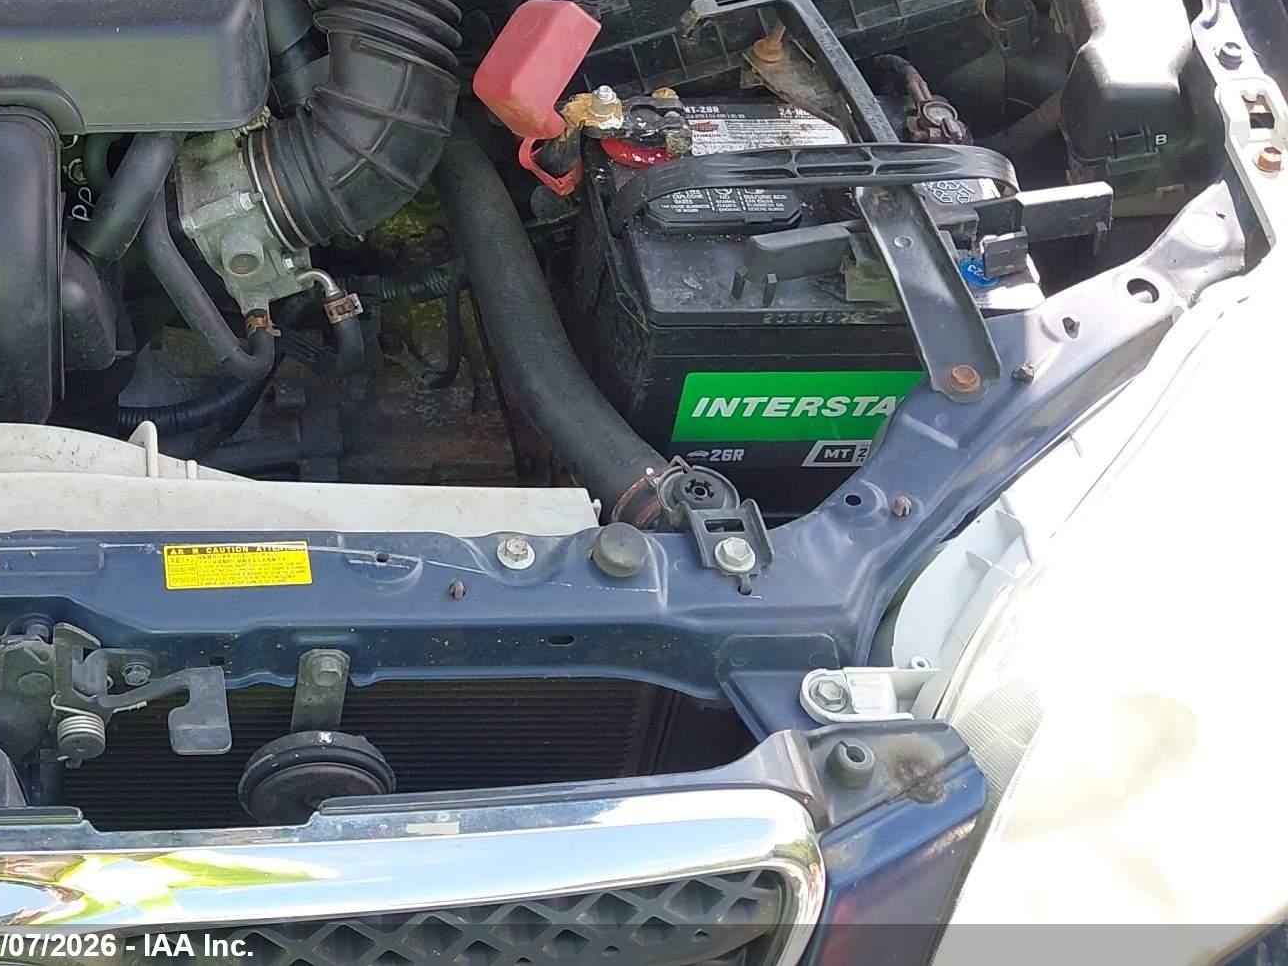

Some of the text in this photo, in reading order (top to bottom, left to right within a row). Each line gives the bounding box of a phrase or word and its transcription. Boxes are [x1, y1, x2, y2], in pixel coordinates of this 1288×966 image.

[1155, 134, 1168, 146] B
[691, 396, 902, 418] INTERSTA
[709, 448, 745, 462] 26R
[823, 448, 852, 459] MT
[205, 545, 249, 555] CAUTION
